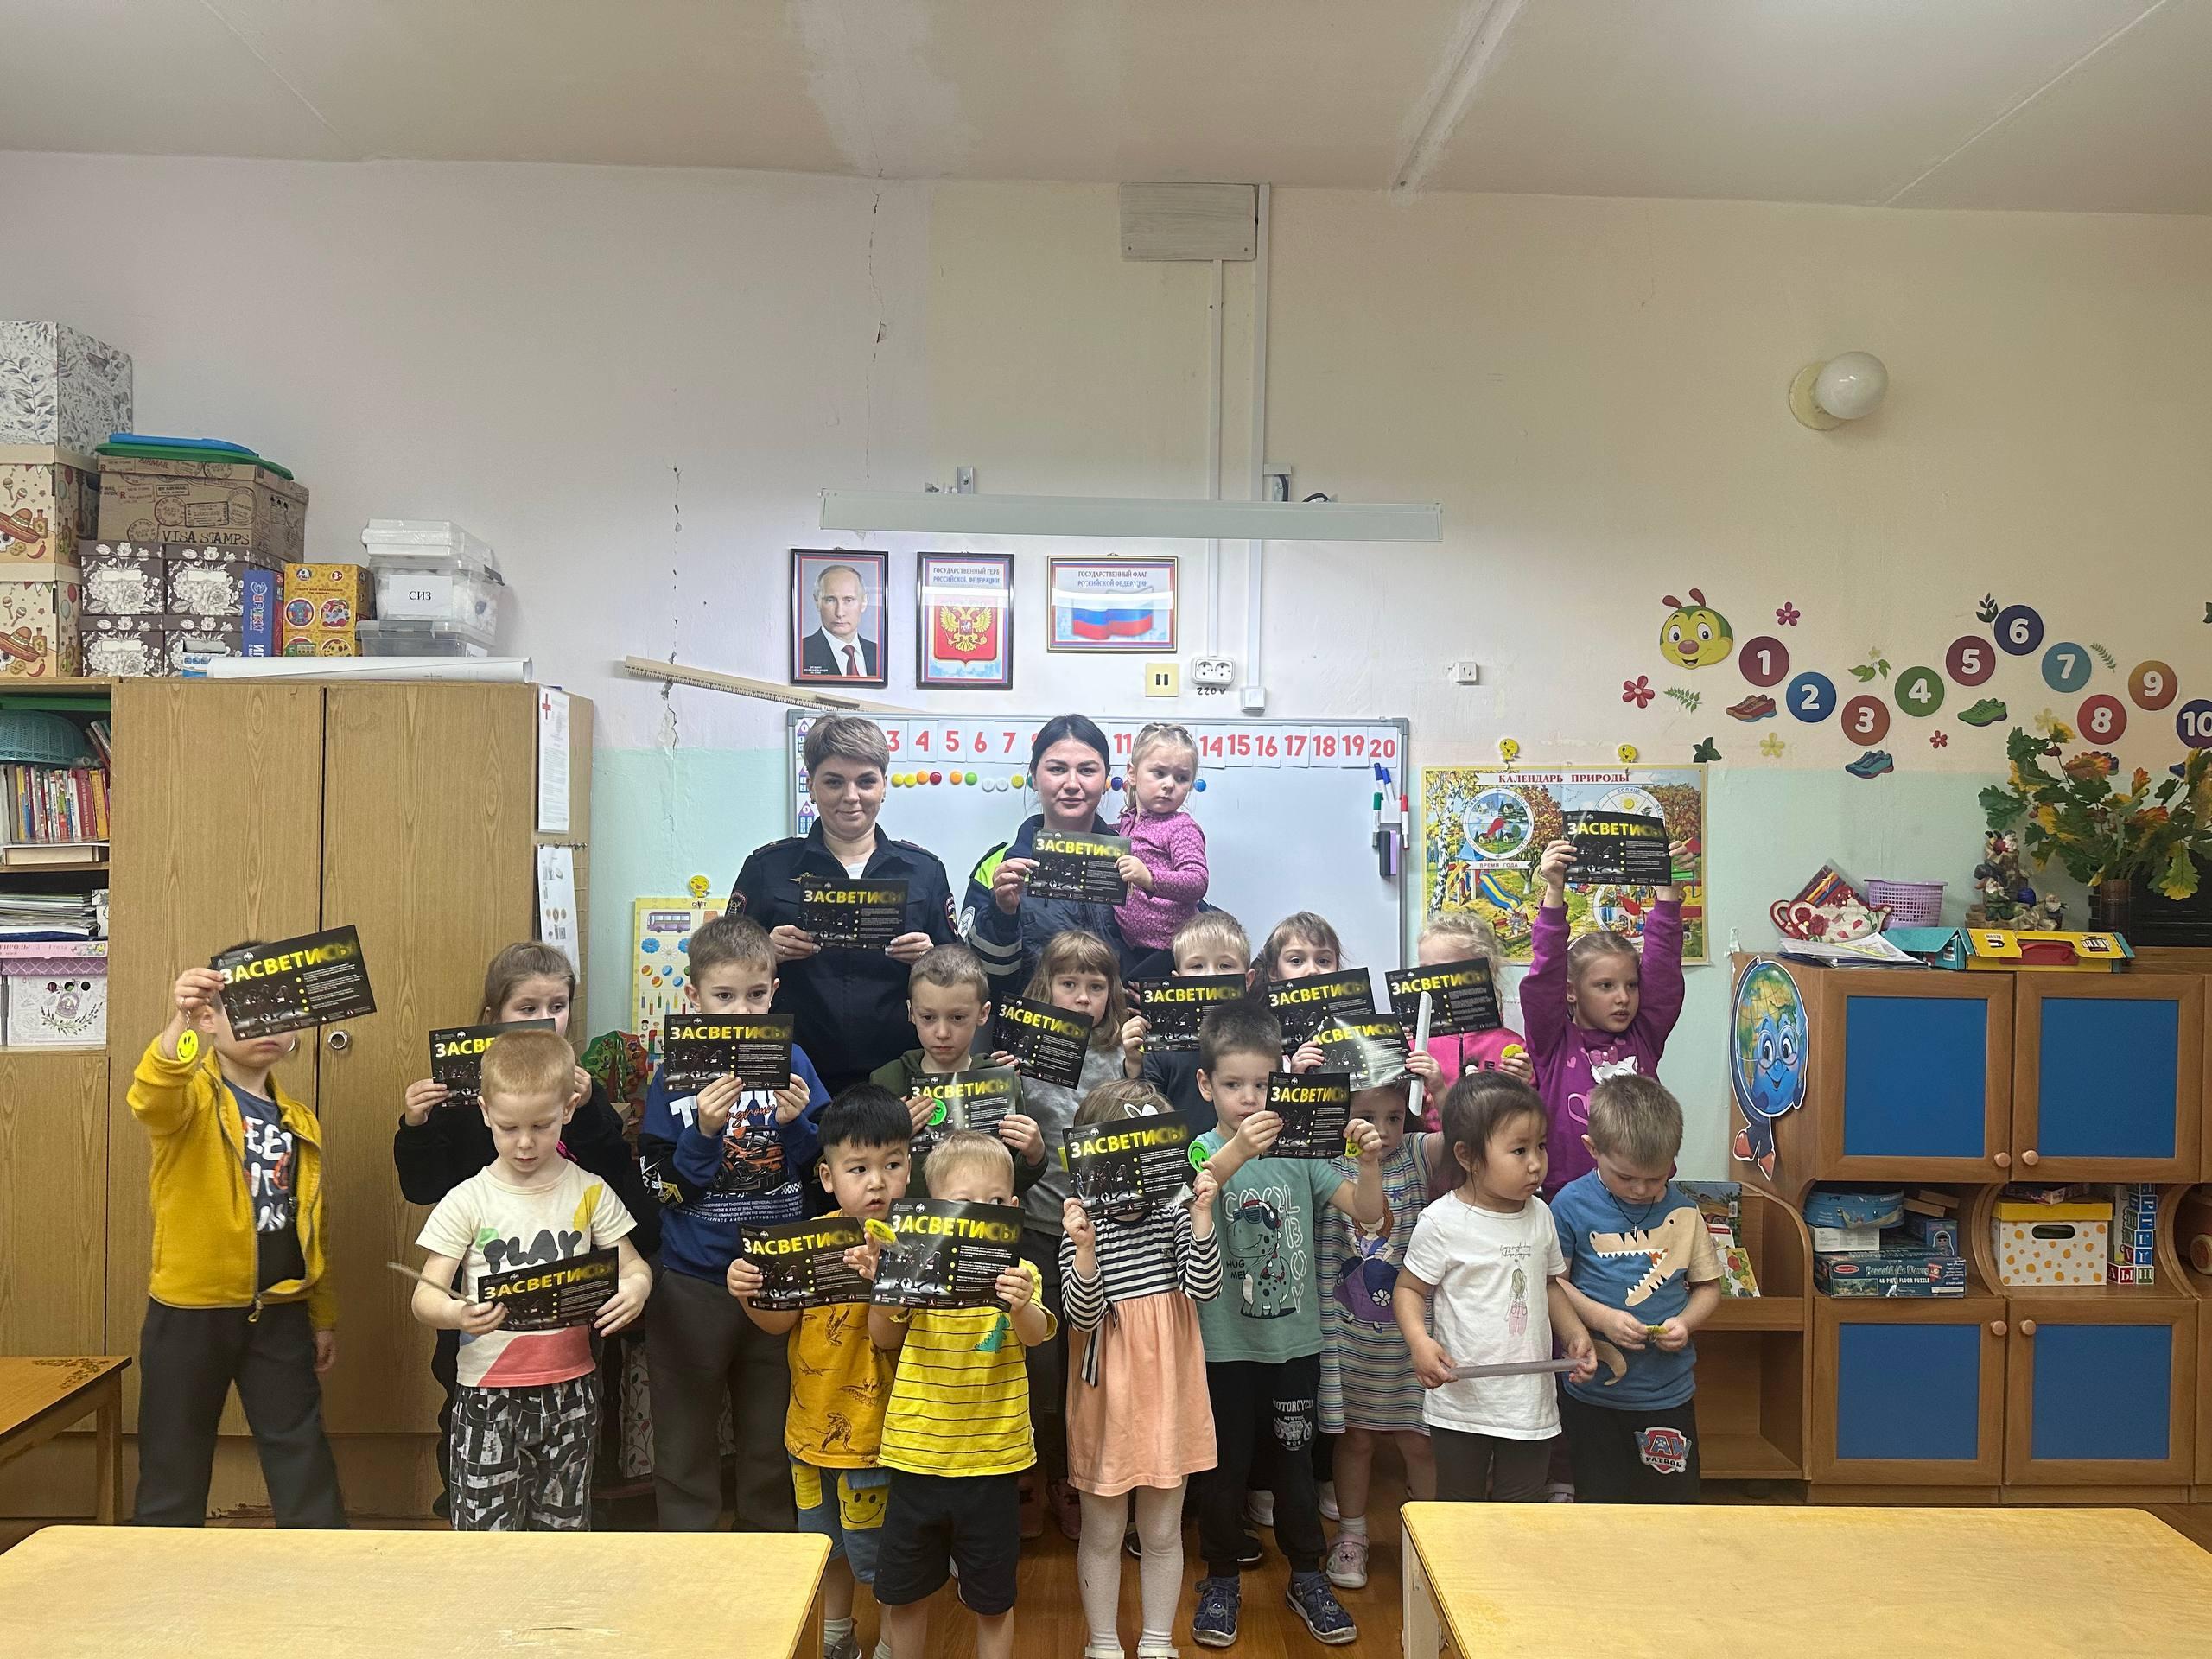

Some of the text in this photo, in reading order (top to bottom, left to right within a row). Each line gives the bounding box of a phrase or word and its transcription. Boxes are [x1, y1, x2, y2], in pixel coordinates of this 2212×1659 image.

[162, 530, 250, 546] VISA STAMPS
[933, 567, 986, 575] ГОСУДАРСТВЕННЫЙ
[969, 576, 1000, 585] ФЕДЕРАЦИИ
[1078, 569, 1132, 578] ГОСУДАРСТВЕННЫЙ
[409, 591, 432, 601] СИЗ
[2009, 618, 2029, 644] 6
[1757, 649, 1770, 676] 1
[1961, 648, 1980, 675] 5
[2057, 653, 2075, 679] 7
[1197, 687, 1217, 696] 220
[1801, 684, 1820, 710] 2
[1908, 678, 1932, 704] 4
[2143, 671, 2164, 697] 9
[1854, 706, 1875, 734] 3
[2091, 707, 2113, 733] 8
[2182, 711, 2212, 737] 10
[887, 730, 900, 752] 3
[915, 731, 929, 752] 4
[945, 731, 960, 752] 5
[974, 731, 988, 753] 6
[1002, 732, 1016, 753] 7
[1199, 735, 1224, 758] 14
[1227, 734, 1251, 756] 15
[1255, 735, 1278, 758] 16
[1284, 735, 1308, 756] 17
[1313, 735, 1336, 757] 18
[1341, 734, 1364, 756] 19
[1370, 738, 1395, 758] 20
[1499, 772, 1630, 783] КАЛЕНДАРЬ ПРИРОДЫ
[483, 1229, 582, 1274] PLAY
[1226, 1259, 1245, 1268] HUG
[2120, 1269, 2133, 1281] Ы
[1634, 1431, 1692, 1459] PAW
[1646, 1457, 1681, 1468] PATROL
